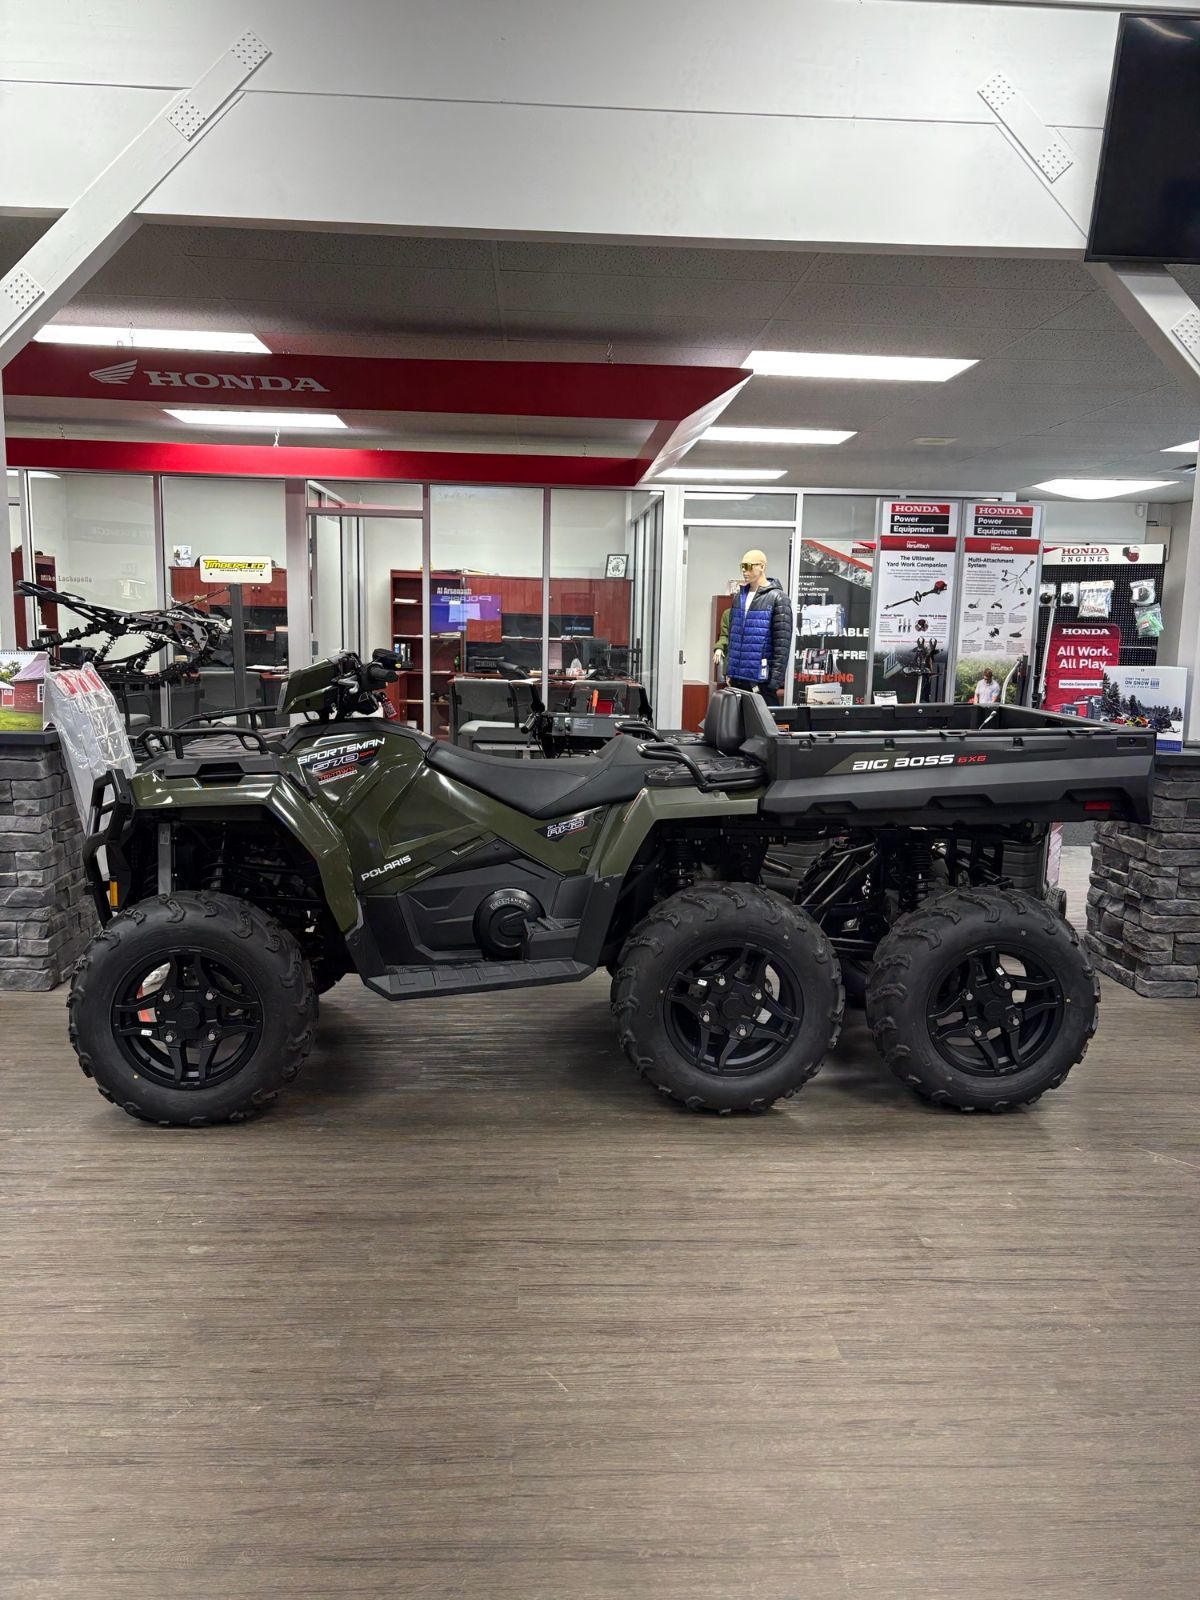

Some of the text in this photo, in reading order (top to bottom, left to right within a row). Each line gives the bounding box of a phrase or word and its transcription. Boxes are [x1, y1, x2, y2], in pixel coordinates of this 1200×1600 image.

[143, 370, 330, 392] HONDA
[895, 505, 940, 513] HONDA
[978, 507, 1024, 515] HONDA
[978, 517, 1002, 525] Power
[893, 525, 935, 534] Equipment
[977, 527, 1018, 536] Equipment
[1061, 547, 1110, 555] HONDA
[1057, 646, 1113, 657] All Work.
[1059, 659, 1076, 669] All
[297, 737, 386, 765] SPORTSMAN
[311, 752, 359, 773] 570
[852, 759, 889, 771] BIG
[893, 754, 955, 768] BOSS
[360, 854, 412, 882] POLARIS
